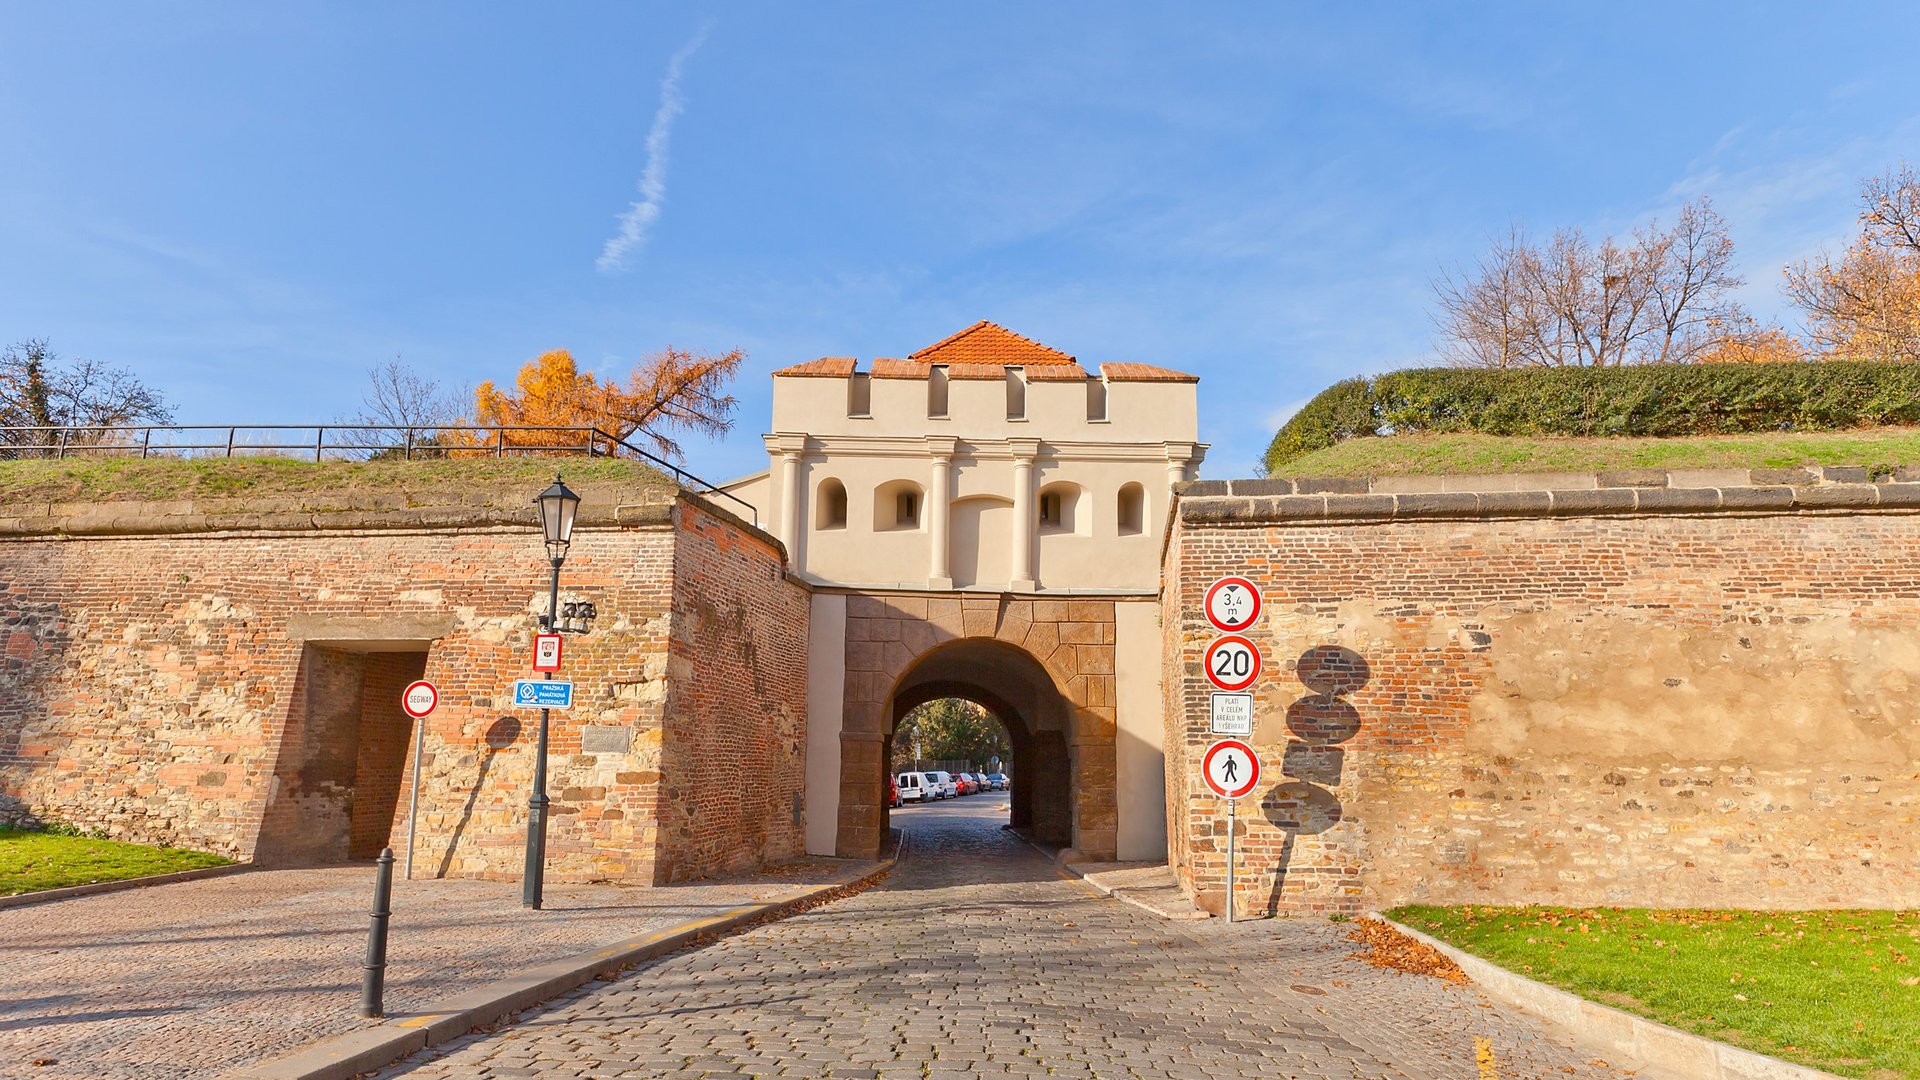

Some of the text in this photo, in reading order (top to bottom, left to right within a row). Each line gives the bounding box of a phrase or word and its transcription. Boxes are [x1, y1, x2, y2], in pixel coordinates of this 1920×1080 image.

[1224, 593, 1242, 606] 3,4
[1216, 650, 1249, 676] 20
[410, 695, 432, 703] SEGWAY
